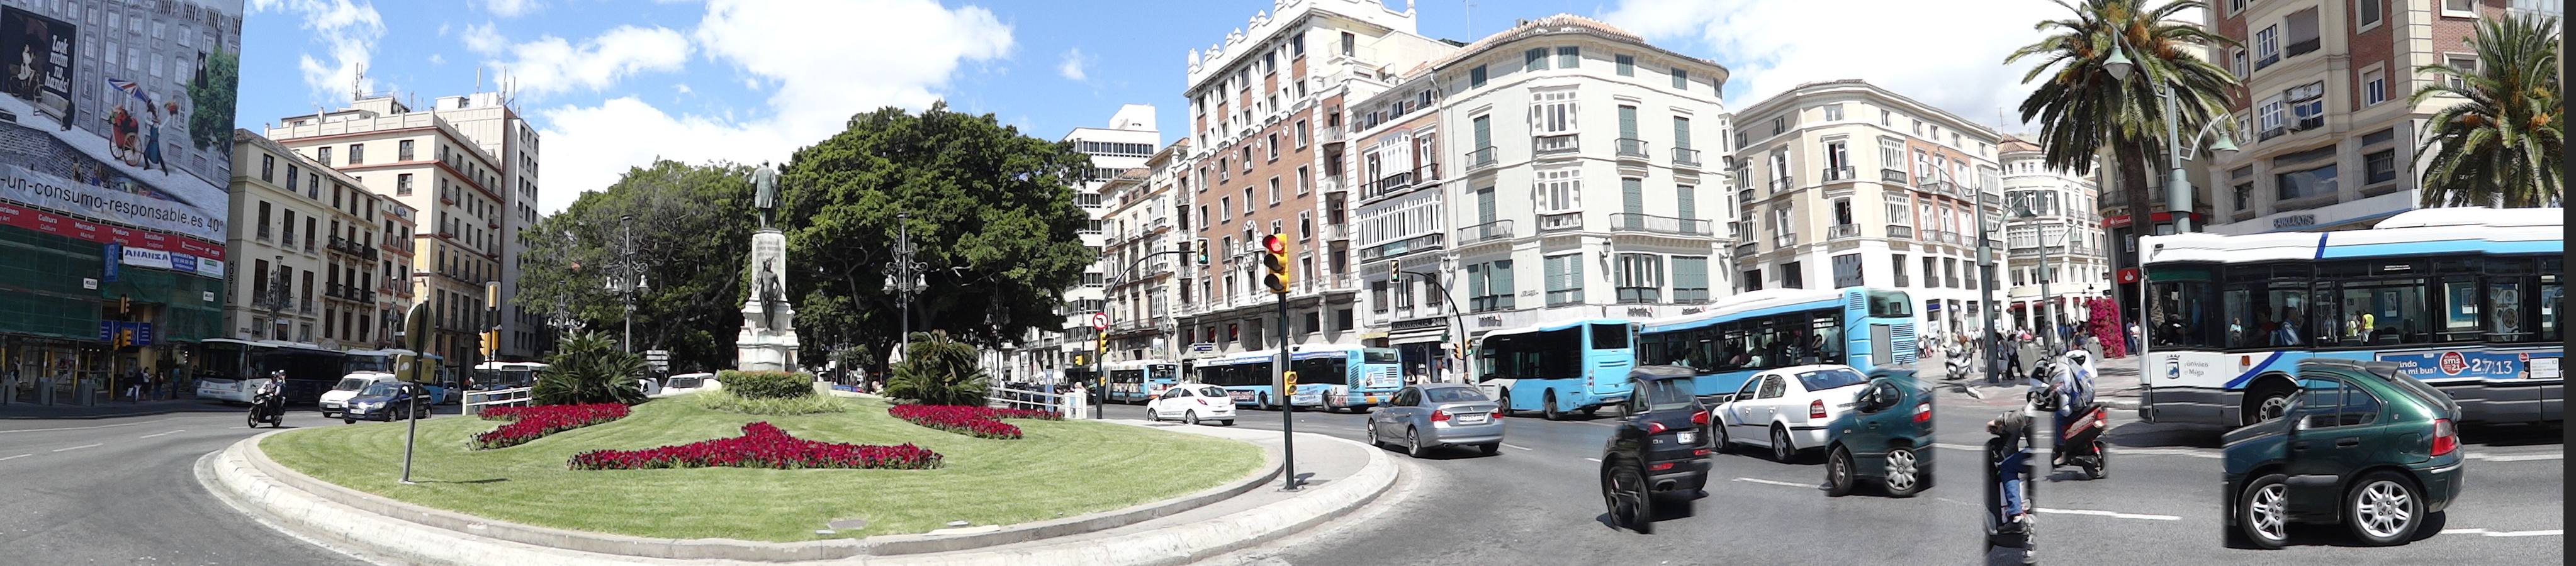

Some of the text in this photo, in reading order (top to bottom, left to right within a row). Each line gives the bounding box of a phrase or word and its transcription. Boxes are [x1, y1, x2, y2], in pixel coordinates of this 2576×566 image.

[52, 35, 69, 55] Look
[45, 71, 70, 93] hands!
[53, 65, 64, 79] no
[227, 260, 235, 304] HOSTAL
